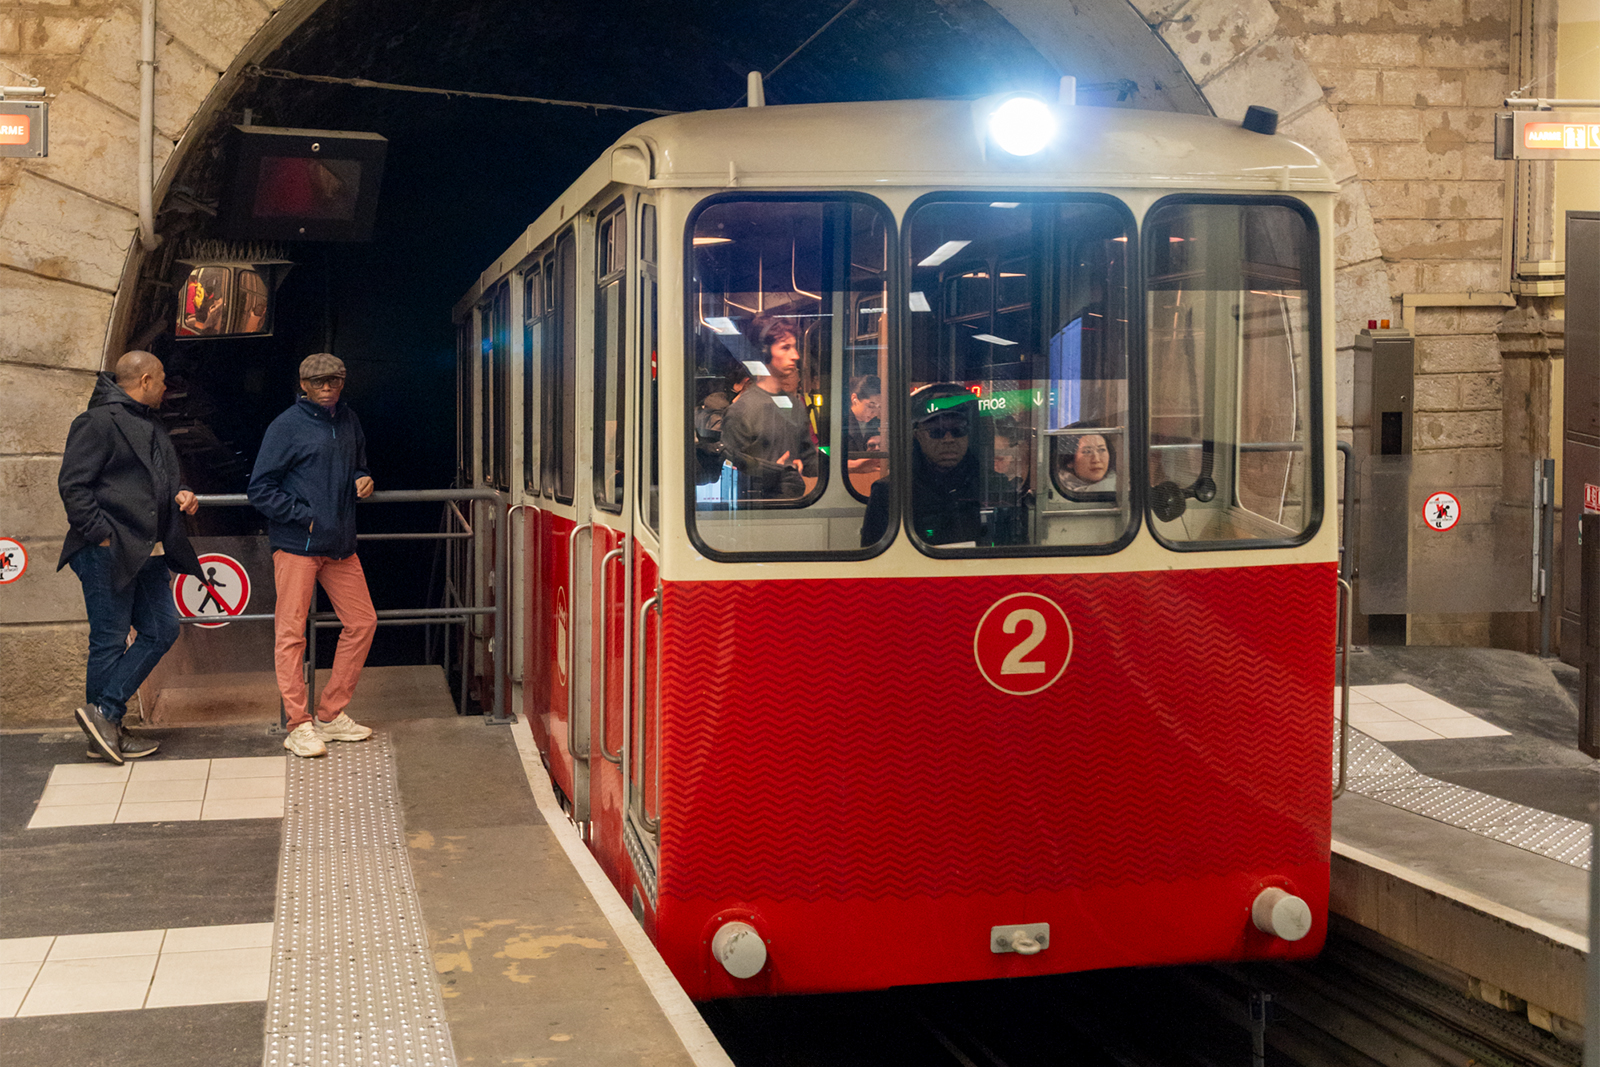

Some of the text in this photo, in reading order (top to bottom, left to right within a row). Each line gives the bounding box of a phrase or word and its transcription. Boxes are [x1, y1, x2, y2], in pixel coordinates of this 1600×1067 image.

[0, 125, 25, 135] RME
[1528, 131, 1562, 141] ALARME
[1000, 608, 1047, 675] 2
